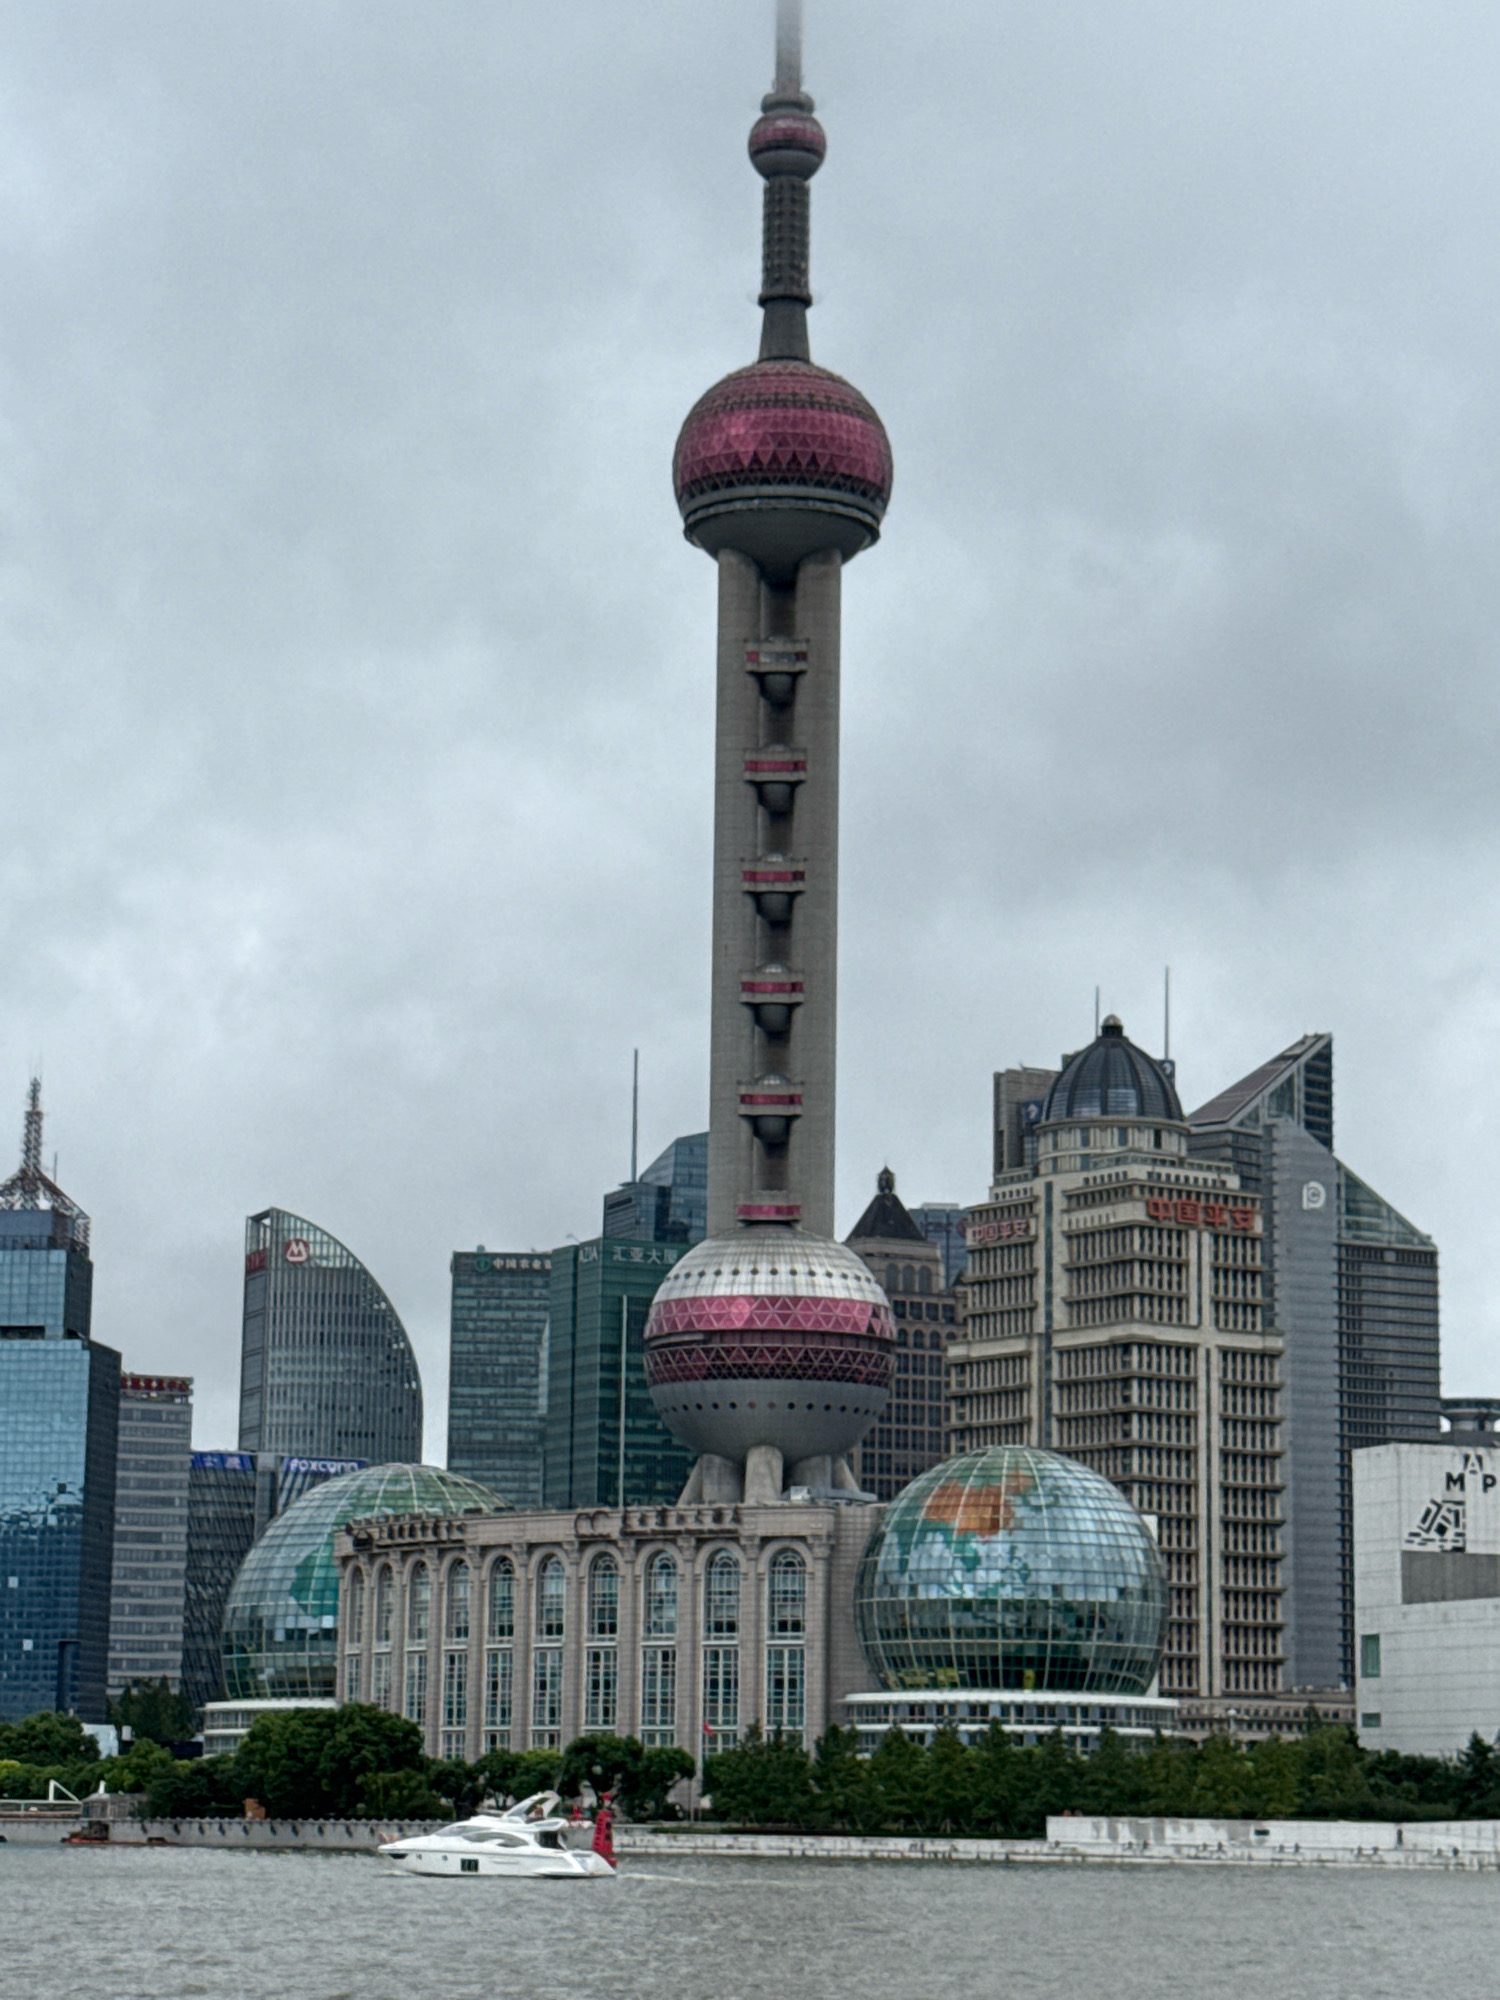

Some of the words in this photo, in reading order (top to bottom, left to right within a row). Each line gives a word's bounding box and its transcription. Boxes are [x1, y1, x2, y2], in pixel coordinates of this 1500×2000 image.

[1148, 1197, 1254, 1231] 中国平安
[971, 1219, 1028, 1243] 中国平安
